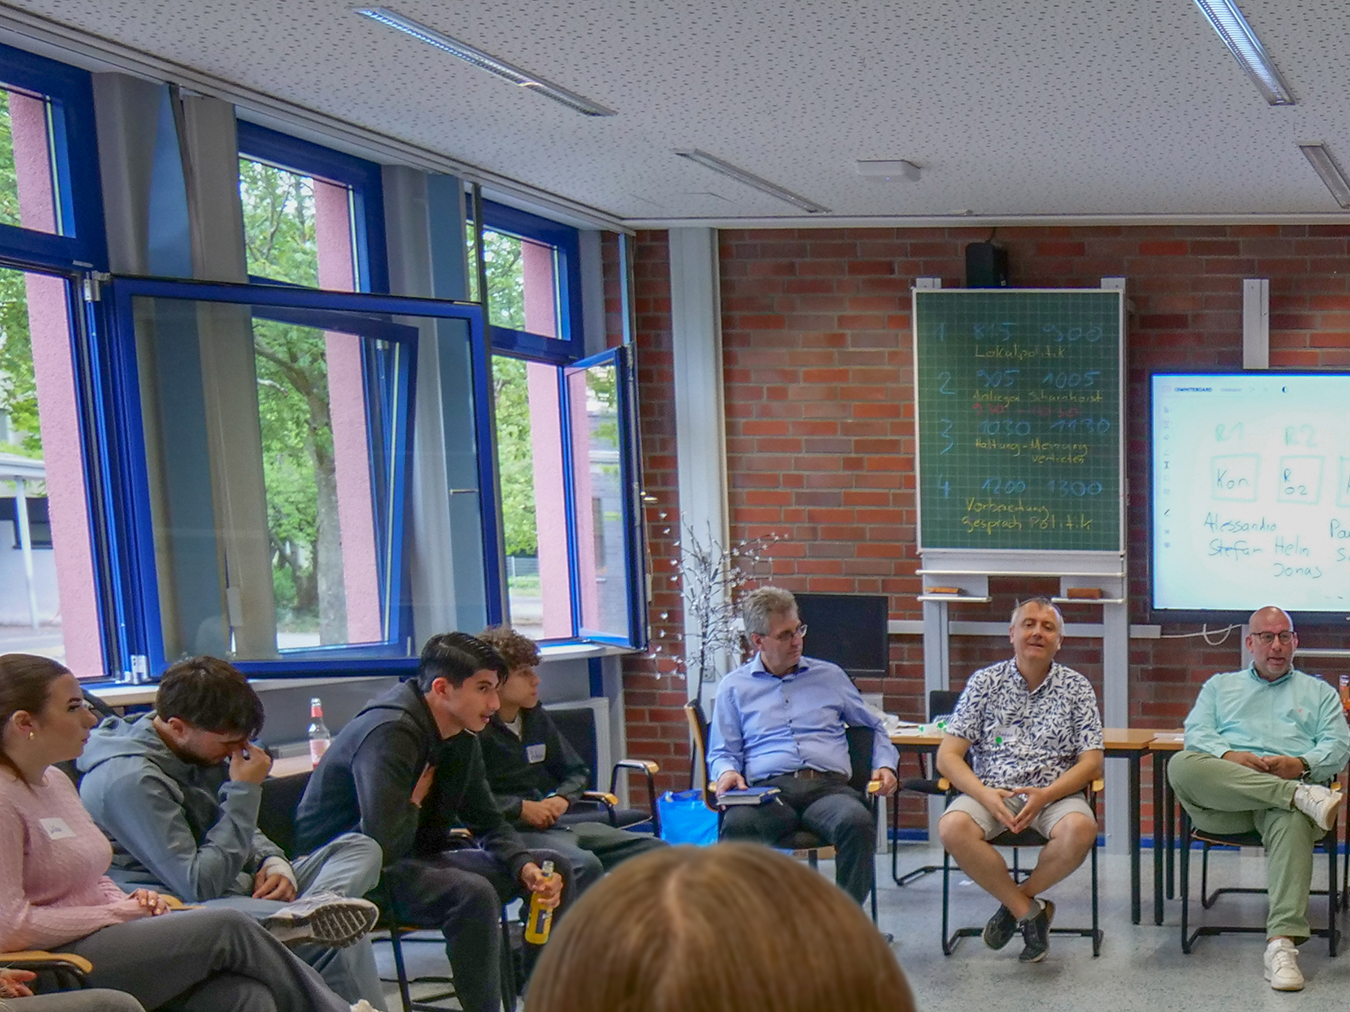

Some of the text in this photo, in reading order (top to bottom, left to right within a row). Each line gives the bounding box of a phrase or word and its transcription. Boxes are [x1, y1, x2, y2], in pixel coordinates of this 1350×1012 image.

[938, 371, 957, 395] 2
[1215, 421, 1245, 442] R1
[1284, 424, 1317, 448] R2
[938, 474, 951, 499] 4
[1216, 467, 1250, 490] Kon
[1204, 511, 1277, 534] Alessandro
[1208, 538, 1264, 561] Stefan
[1275, 535, 1310, 557] Helin
[1273, 562, 1324, 579] Jonas
